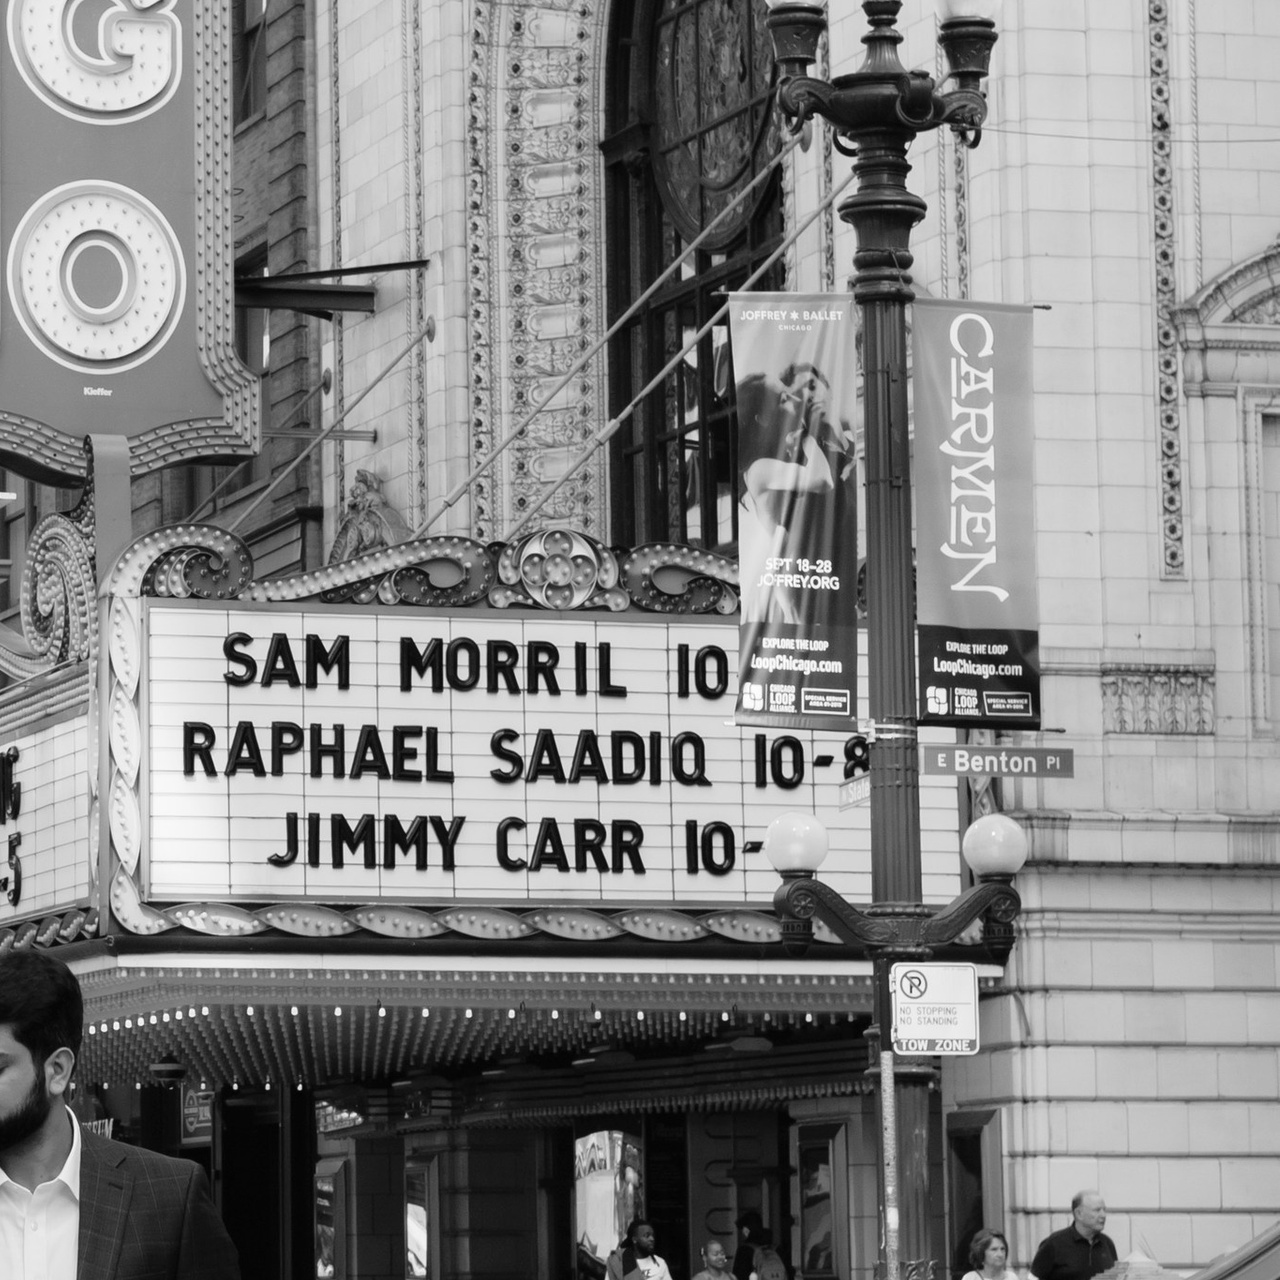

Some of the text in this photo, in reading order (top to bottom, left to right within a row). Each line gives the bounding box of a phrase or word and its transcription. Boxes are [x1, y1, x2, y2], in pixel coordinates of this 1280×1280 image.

[740, 310, 844, 321] JOFFREY BALLET
[777, 324, 812, 332] CHICAGO
[939, 313, 1010, 603] CARMEN
[765, 558, 832, 573] SEPT 18-28
[762, 637, 829, 652] EXPLORE THE LOOP
[946, 641, 1008, 655] EXPLORE THE LOOP
[223, 631, 351, 691] SAM
[400, 637, 627, 698] MORRIL
[751, 653, 842, 675] LoopChicago.com
[933, 657, 1023, 679] LoopChicago.com
[770, 693, 796, 705] LOOP
[955, 695, 978, 708] LOOP
[183, 721, 455, 784] RAPHAEL
[490, 728, 712, 787] SAADIQ
[938, 754, 947, 767] E
[954, 750, 1037, 772] Benton
[848, 776, 870, 803] State
[267, 812, 466, 872] JIMMY
[496, 817, 646, 875] CARR
[900, 1007, 957, 1015] NO STOPPING
[900, 1017, 958, 1025] NO STANDING
[900, 1039, 971, 1051] TOW ZONE
